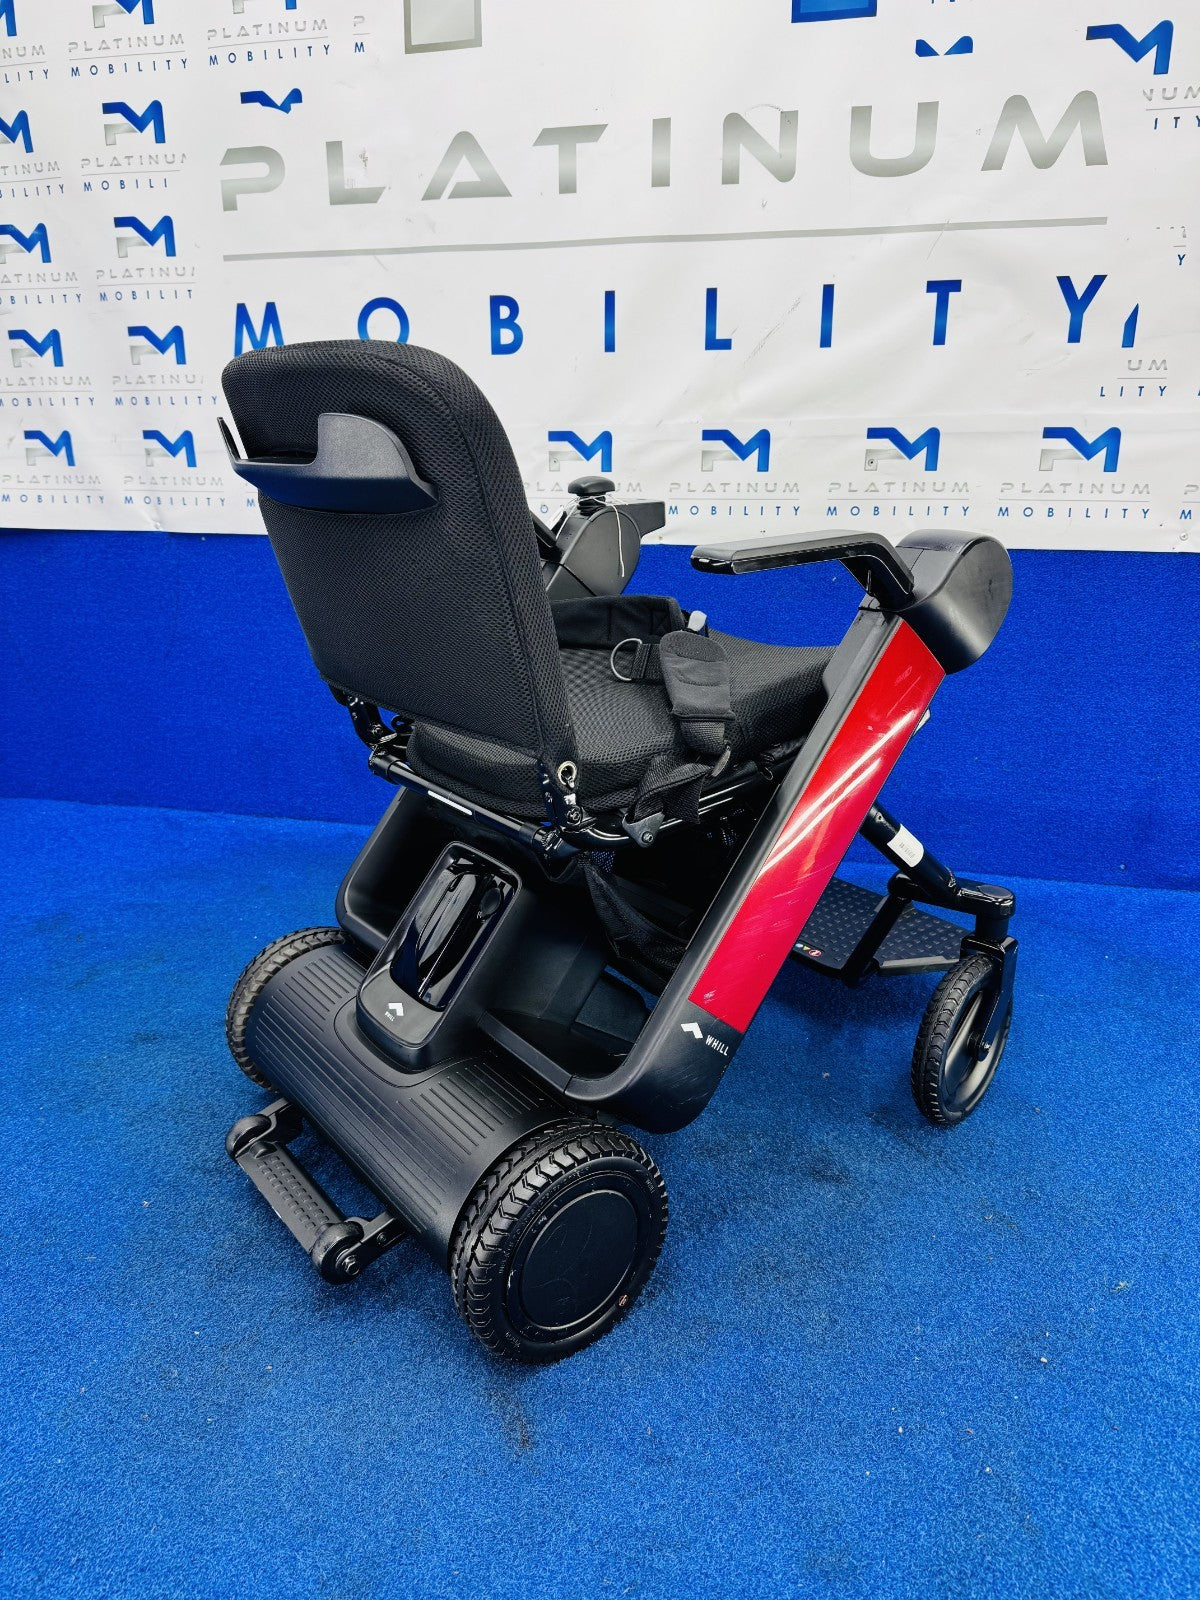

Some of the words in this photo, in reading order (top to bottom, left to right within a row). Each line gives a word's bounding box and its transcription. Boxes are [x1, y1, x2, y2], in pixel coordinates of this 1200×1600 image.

[207, 19, 329, 41] PLATINUM
[68, 34, 185, 53] PLATINUM
[209, 44, 331, 66] MOBILITY
[70, 58, 188, 78] MOBILITY
[219, 90, 1108, 212] PLATINUM
[96, 267, 195, 280] PLATINU
[234, 275, 1108, 356] MOBILITY
[0, 377, 92, 388] LATINUM
[112, 375, 204, 386] PLATINU
[114, 395, 218, 408] MOBILITY
[2, 475, 102, 486] PLATINUM
[124, 476, 224, 487] PLATINUM
[669, 482, 800, 493] PLATINUM
[827, 482, 970, 493] PLATINUM
[1001, 483, 1151, 495] PLATINUM
[2, 494, 106, 505] MOBILITY
[124, 495, 226, 507] MOBILITY
[668, 504, 801, 516] MOBILITY
[826, 505, 970, 517] MOBILITY
[997, 506, 1151, 519] MOBILITY
[705, 1035, 729, 1056] WHILL
